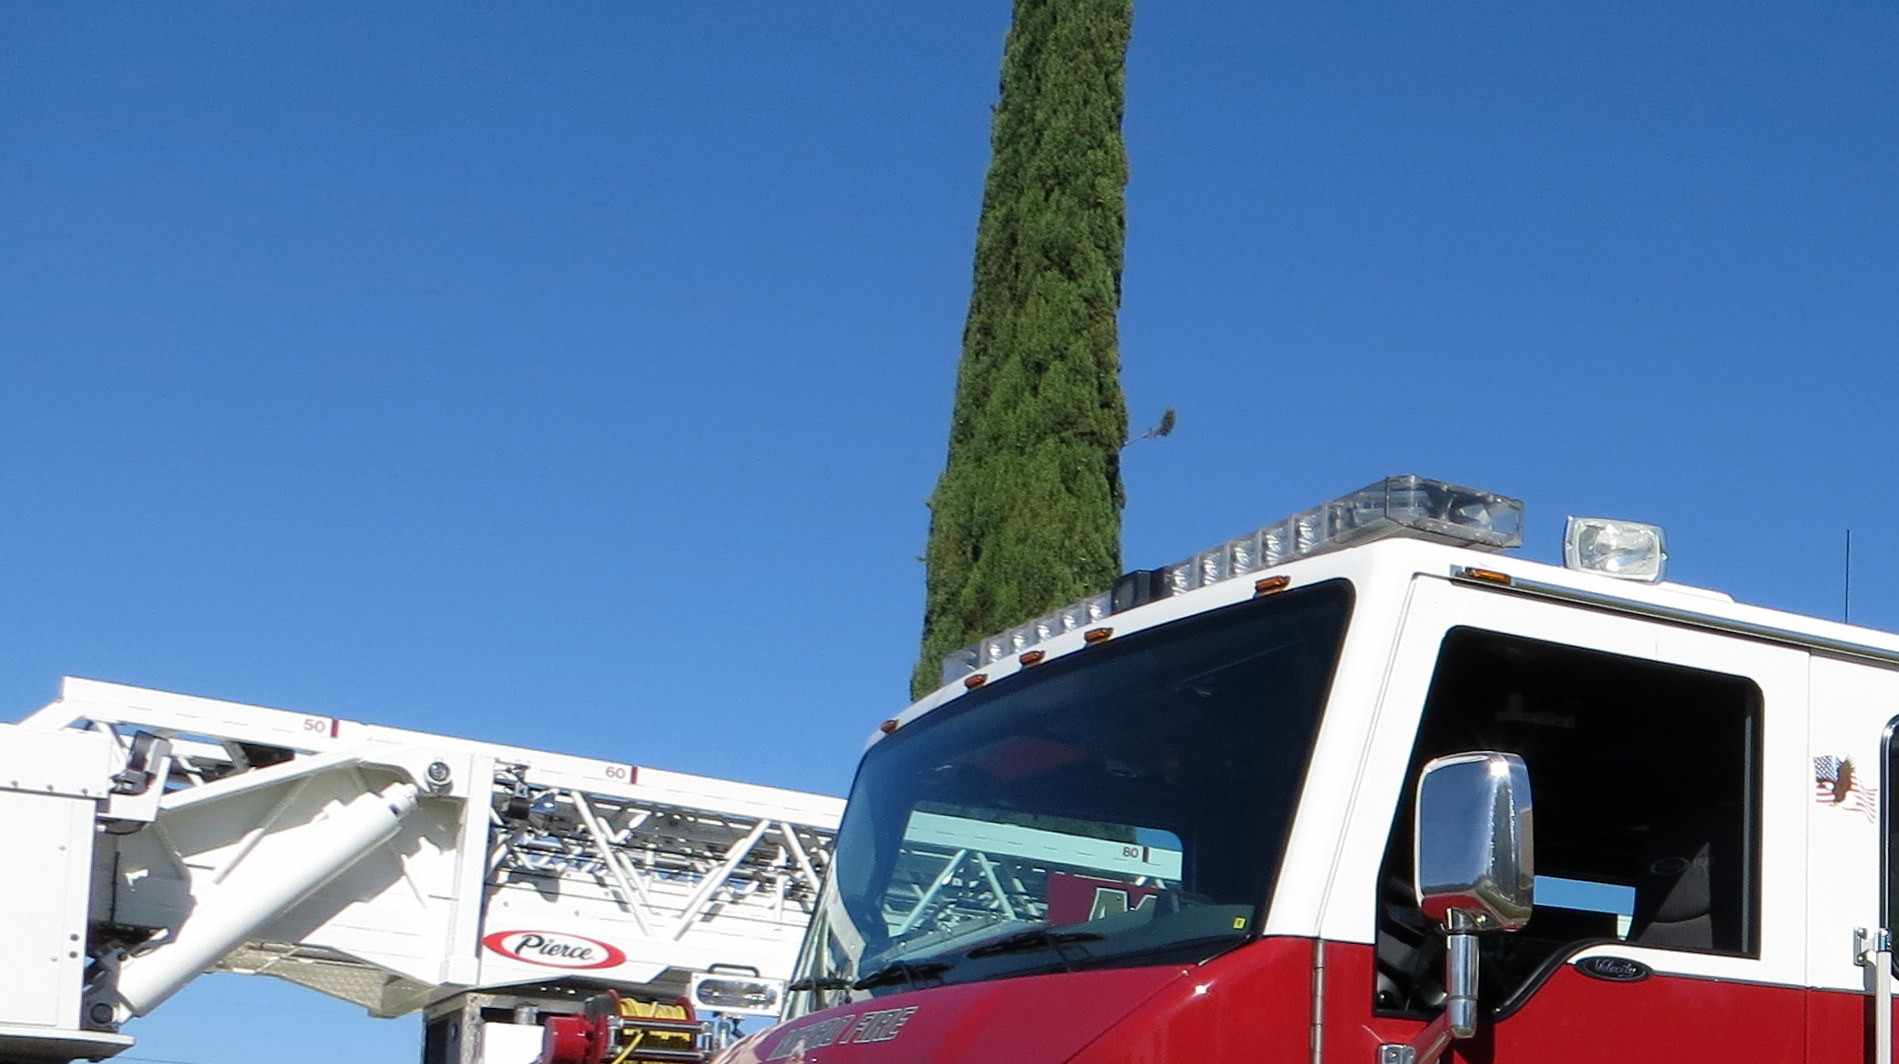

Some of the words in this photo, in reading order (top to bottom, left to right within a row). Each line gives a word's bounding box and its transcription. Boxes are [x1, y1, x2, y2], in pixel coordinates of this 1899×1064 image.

[303, 719, 326, 734] 50
[605, 766, 626, 780] 60
[1123, 846, 1139, 858] 80
[514, 933, 593, 960] Pierce
[838, 1006, 919, 1045] FIRE
